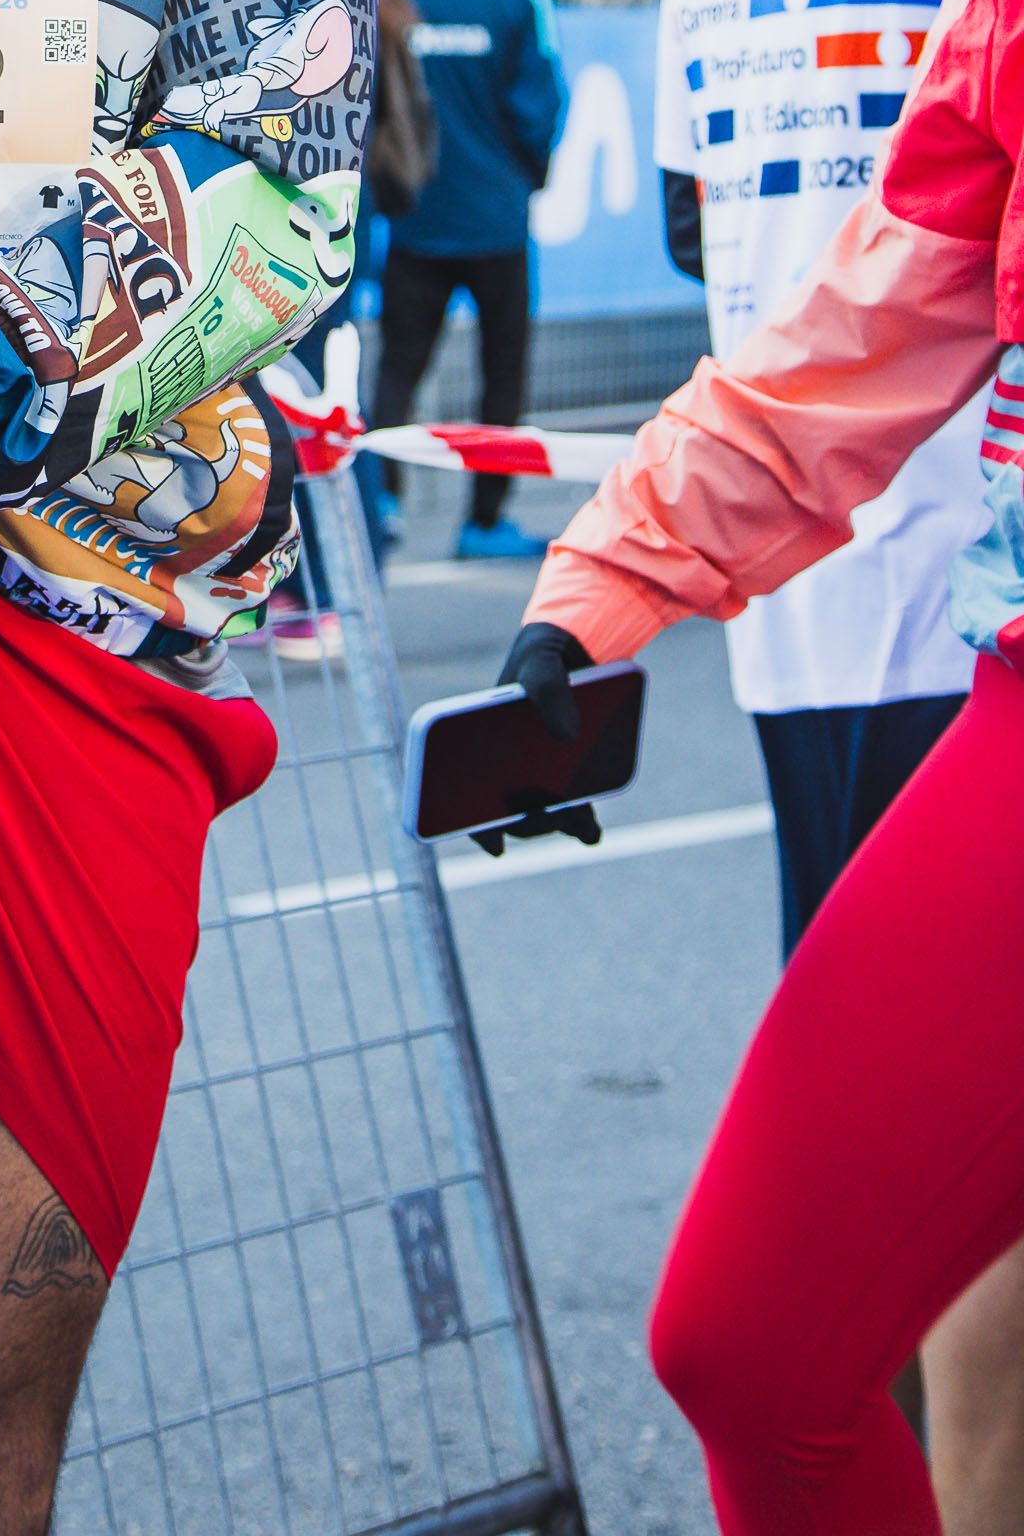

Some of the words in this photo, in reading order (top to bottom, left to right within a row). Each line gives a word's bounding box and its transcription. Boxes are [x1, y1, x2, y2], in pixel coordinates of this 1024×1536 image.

[170, 16, 227, 76] ME
[67, 199, 75, 207] M
[125, 167, 158, 219] FOR
[230, 245, 299, 325] Delicious
[19, 317, 52, 354] TO
